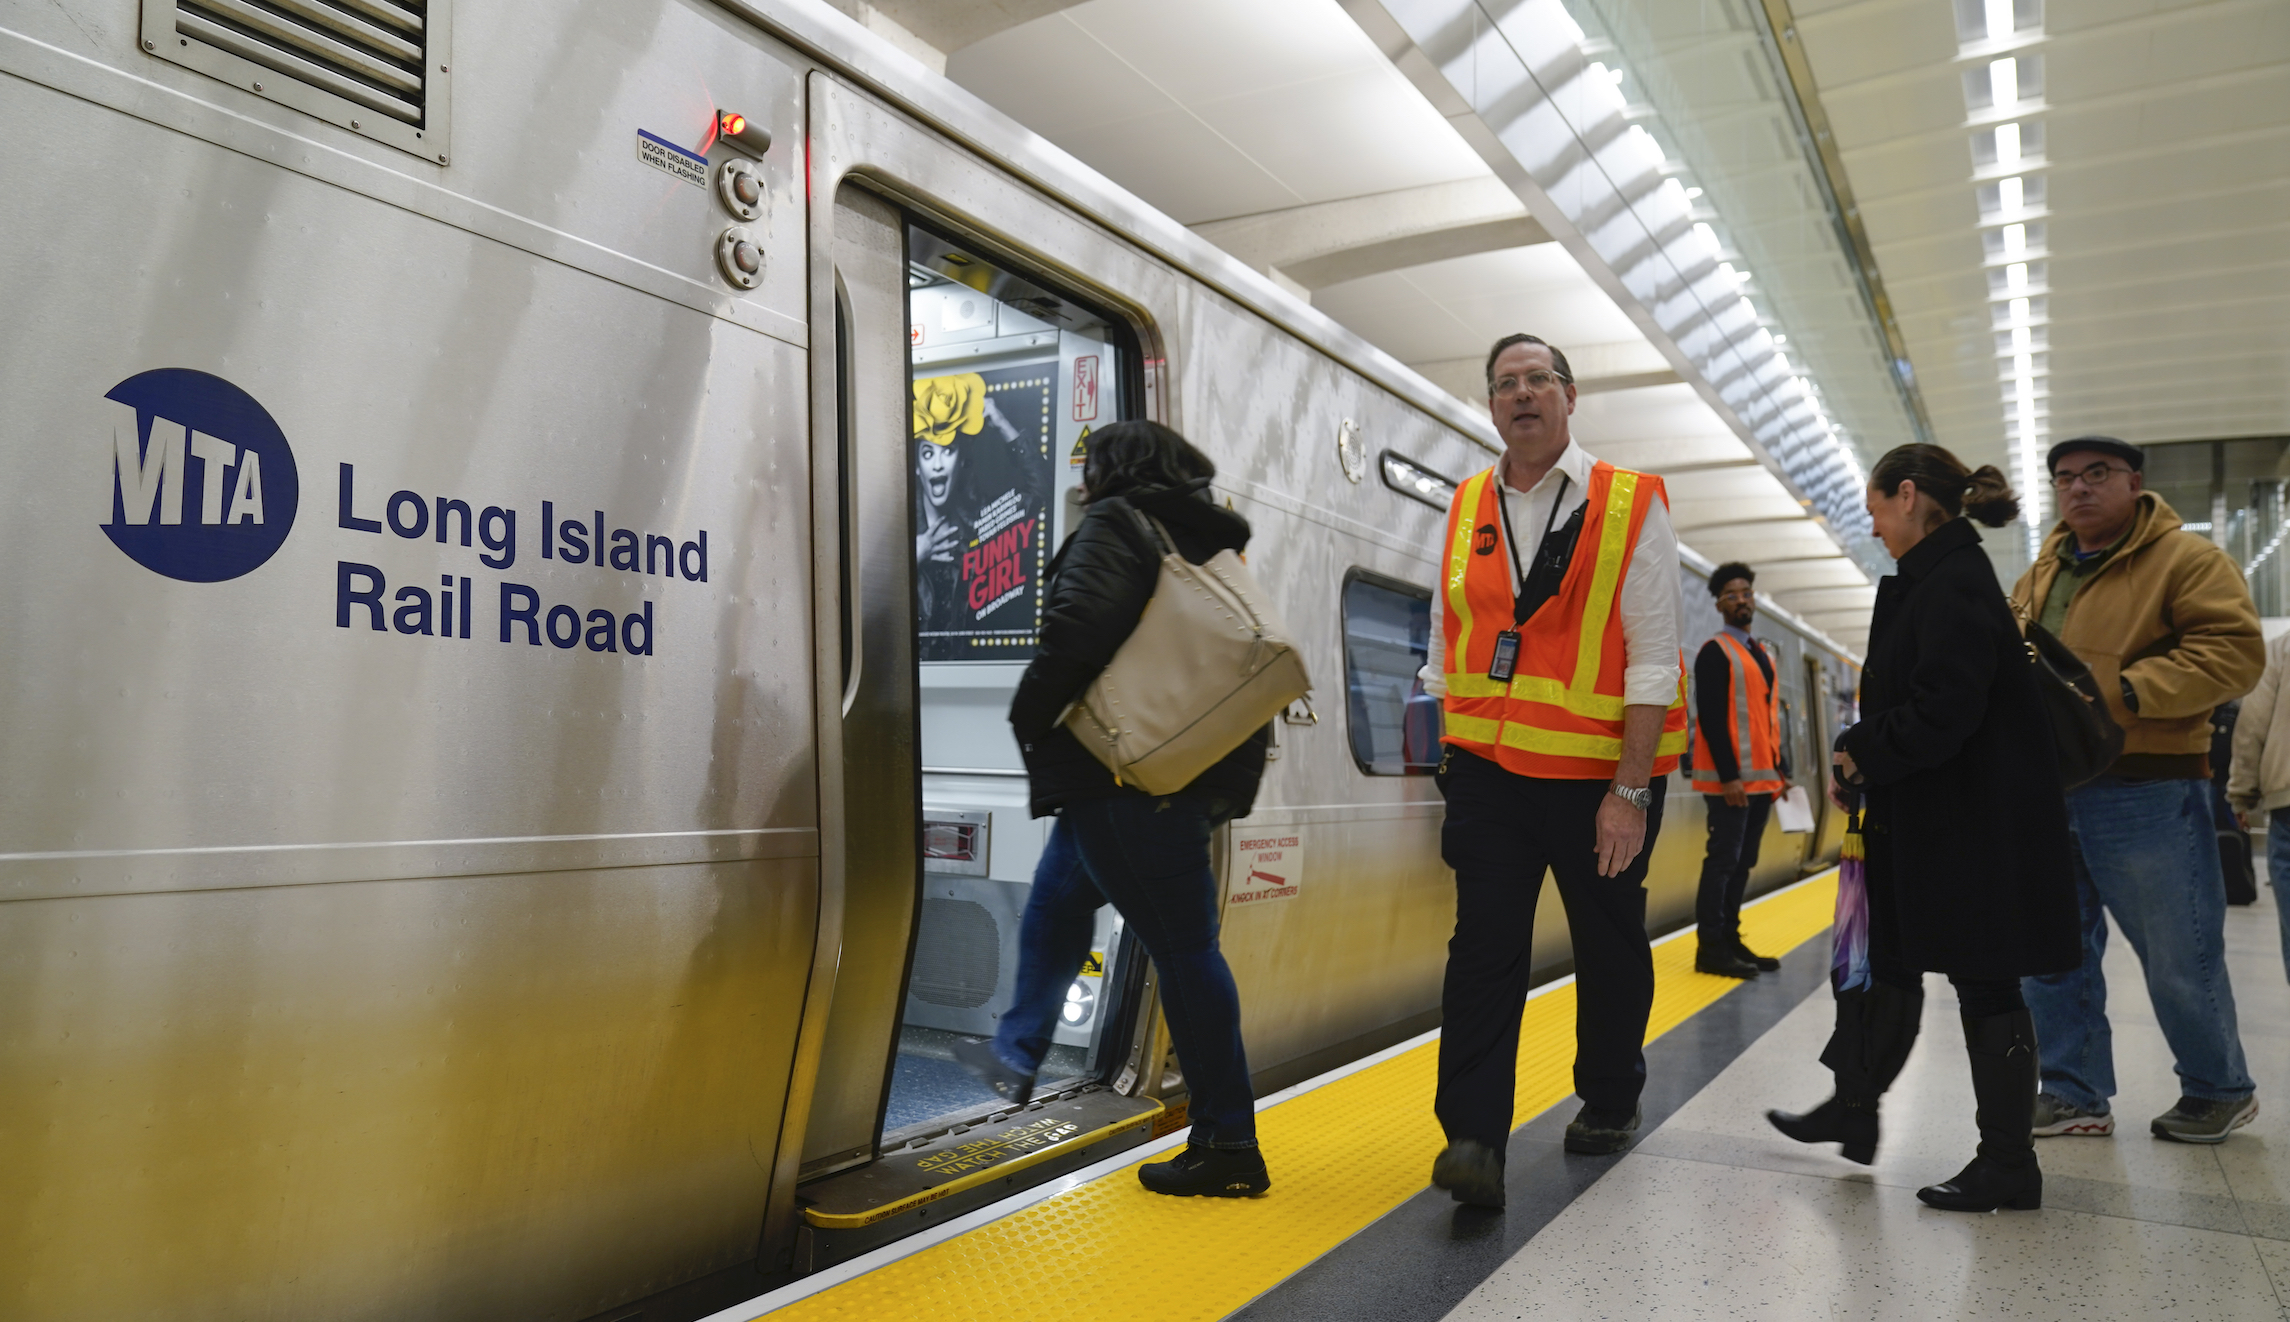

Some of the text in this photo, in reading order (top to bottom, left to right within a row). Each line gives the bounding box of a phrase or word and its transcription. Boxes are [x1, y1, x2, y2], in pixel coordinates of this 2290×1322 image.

[641, 151, 706, 186] WHEN FLASHING
[642, 140, 705, 175] DOOR DISABLED
[1076, 359, 1087, 418] EXIT
[338, 462, 709, 583] Long Island
[962, 518, 1035, 581] FUNNY
[968, 552, 1027, 610] GIRL
[336, 560, 654, 657] Rail Road
[975, 585, 1025, 621] ON BROADWAY
[1240, 836, 1299, 851] EMERGENCY ACCESS
[1258, 851, 1283, 863] WINDOW
[917, 1117, 1061, 1168] WATCH THE GAP
[935, 1149, 1007, 1175] WATCH
[1005, 1138, 1047, 1152] THE
[864, 1209, 891, 1225] CAUTION
[891, 1200, 917, 1216] SURFACE
